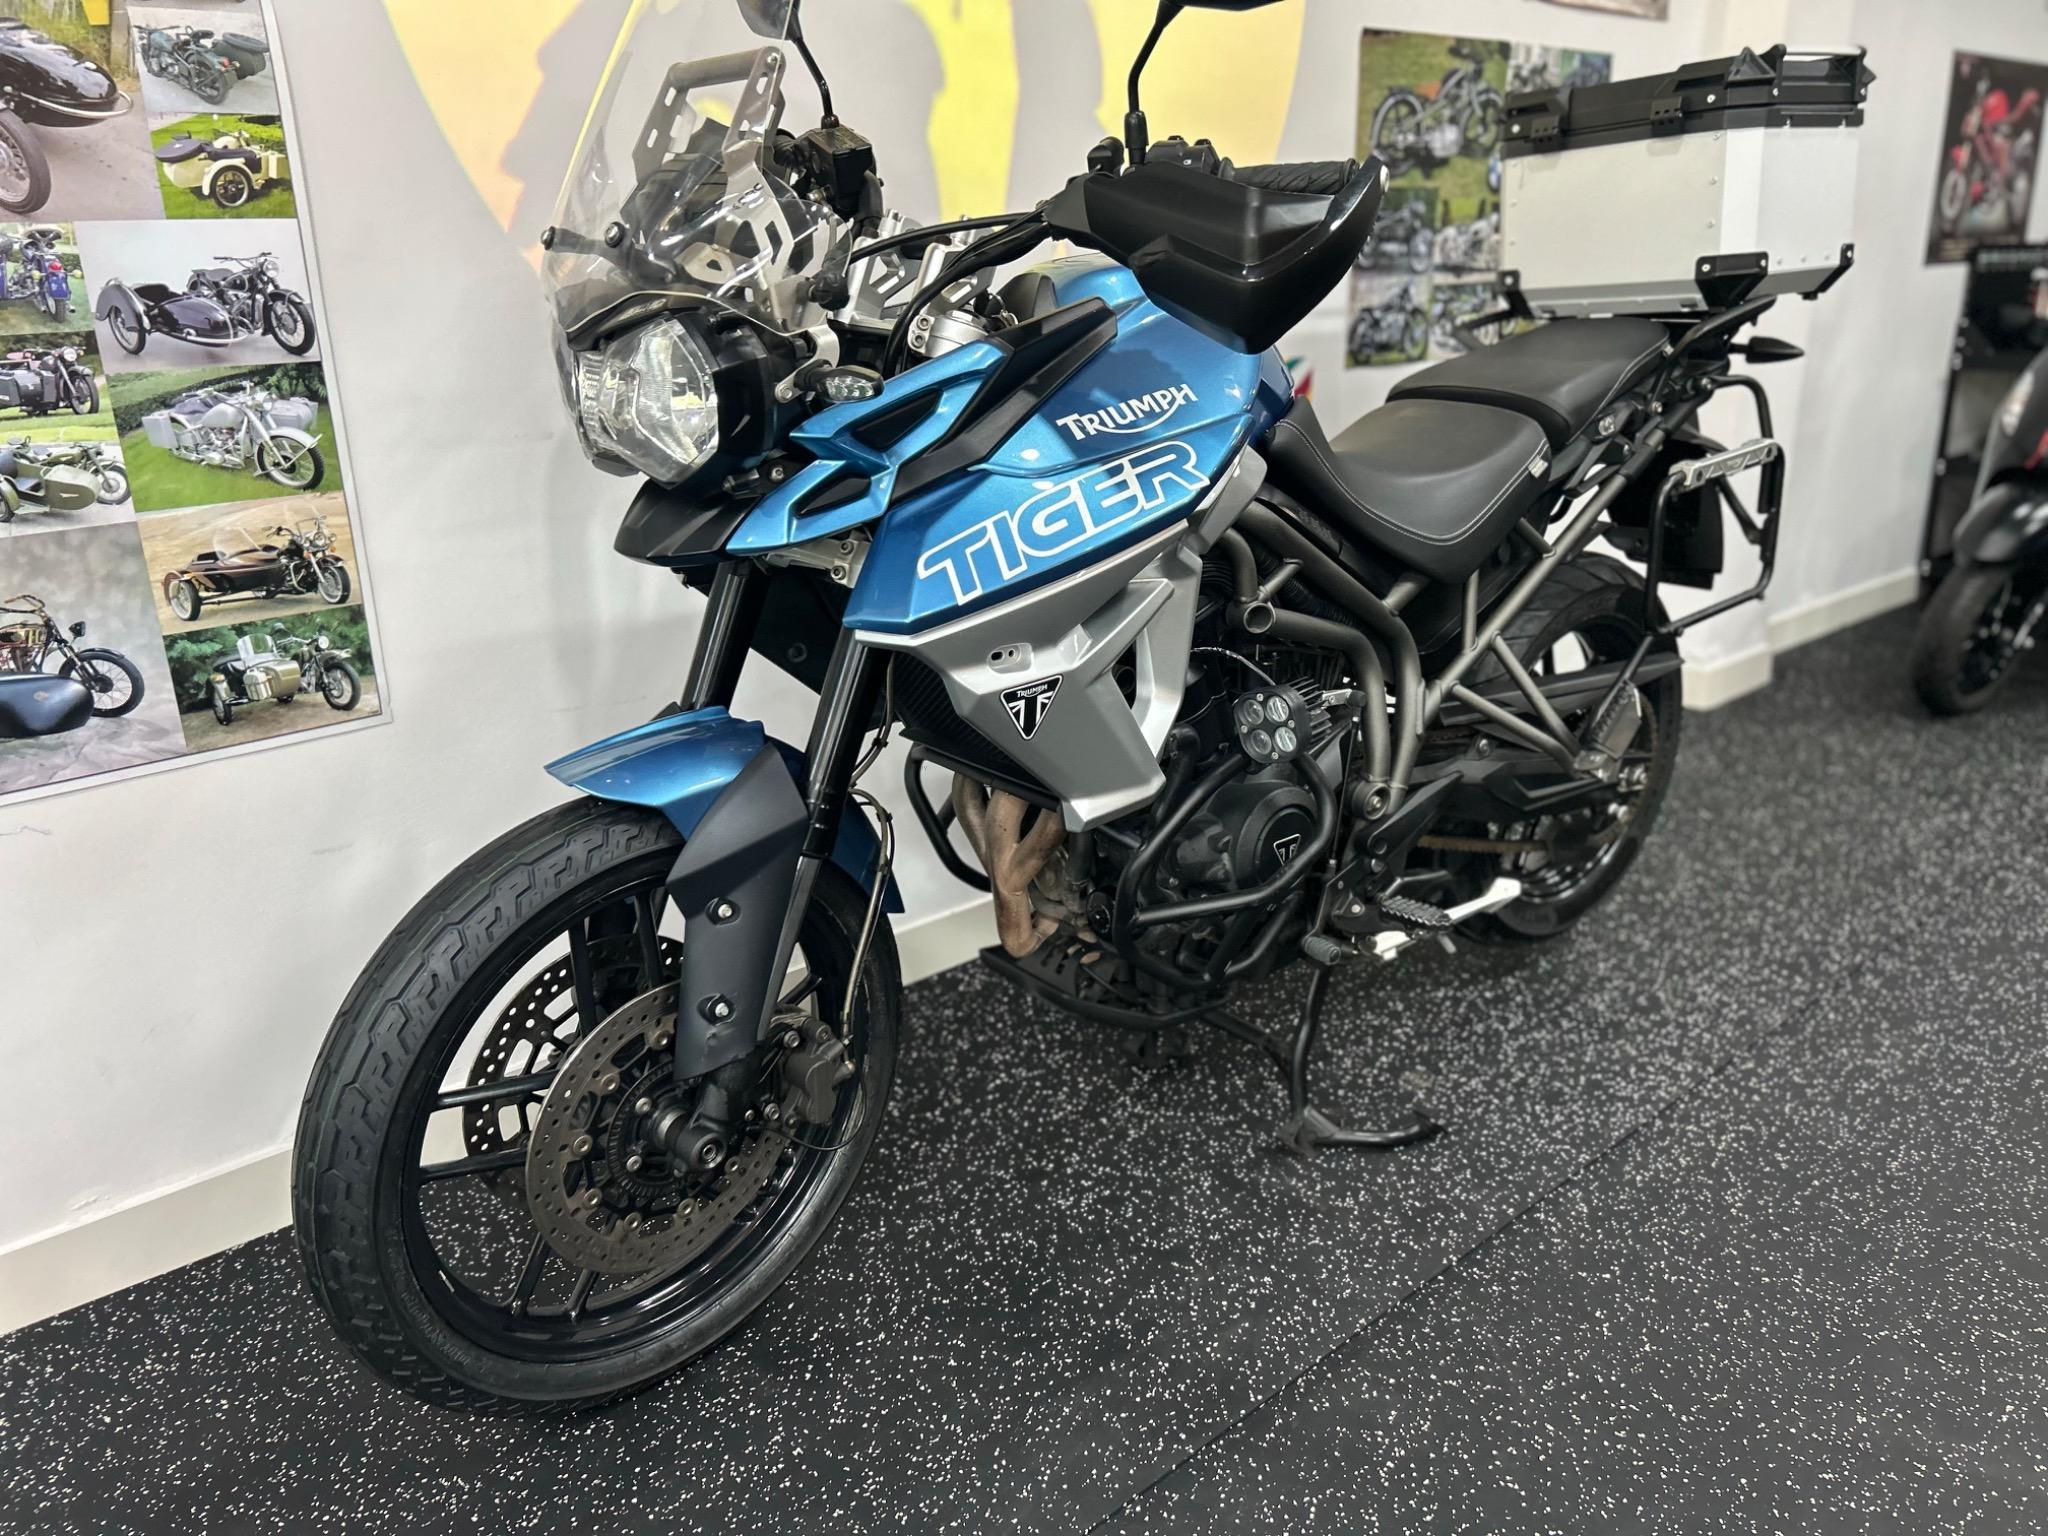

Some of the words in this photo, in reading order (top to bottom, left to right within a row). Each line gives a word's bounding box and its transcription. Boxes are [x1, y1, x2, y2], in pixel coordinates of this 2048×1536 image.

[1056, 384, 1198, 440] TRIUMPH
[917, 441, 1210, 606] TIGER
[1016, 684, 1048, 698] TRIUMPH
